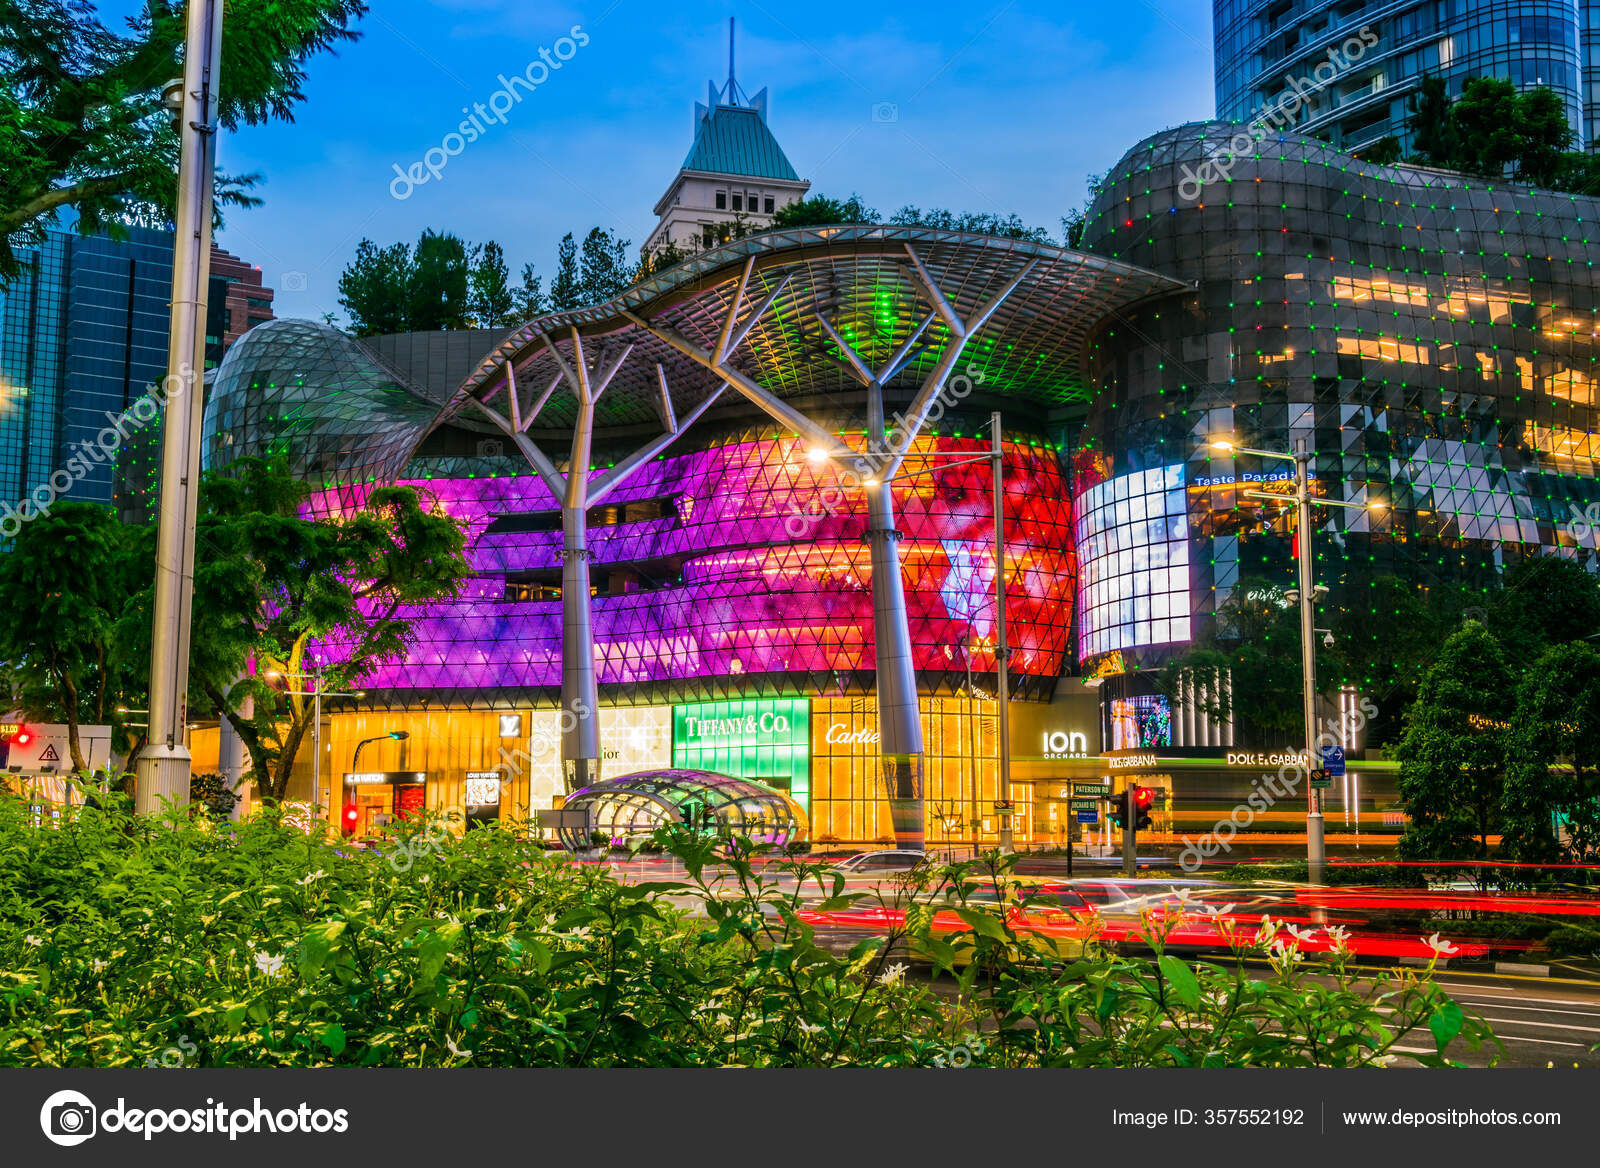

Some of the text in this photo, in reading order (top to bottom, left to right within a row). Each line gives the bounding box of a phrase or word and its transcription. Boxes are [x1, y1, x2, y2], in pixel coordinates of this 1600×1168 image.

[1196, 471, 1315, 486] Taste Paradie
[825, 723, 881, 744] Cartie
[603, 747, 620, 759] ior
[1075, 785, 1100, 793] PATERSON
[1071, 801, 1089, 809] ORCHARD
